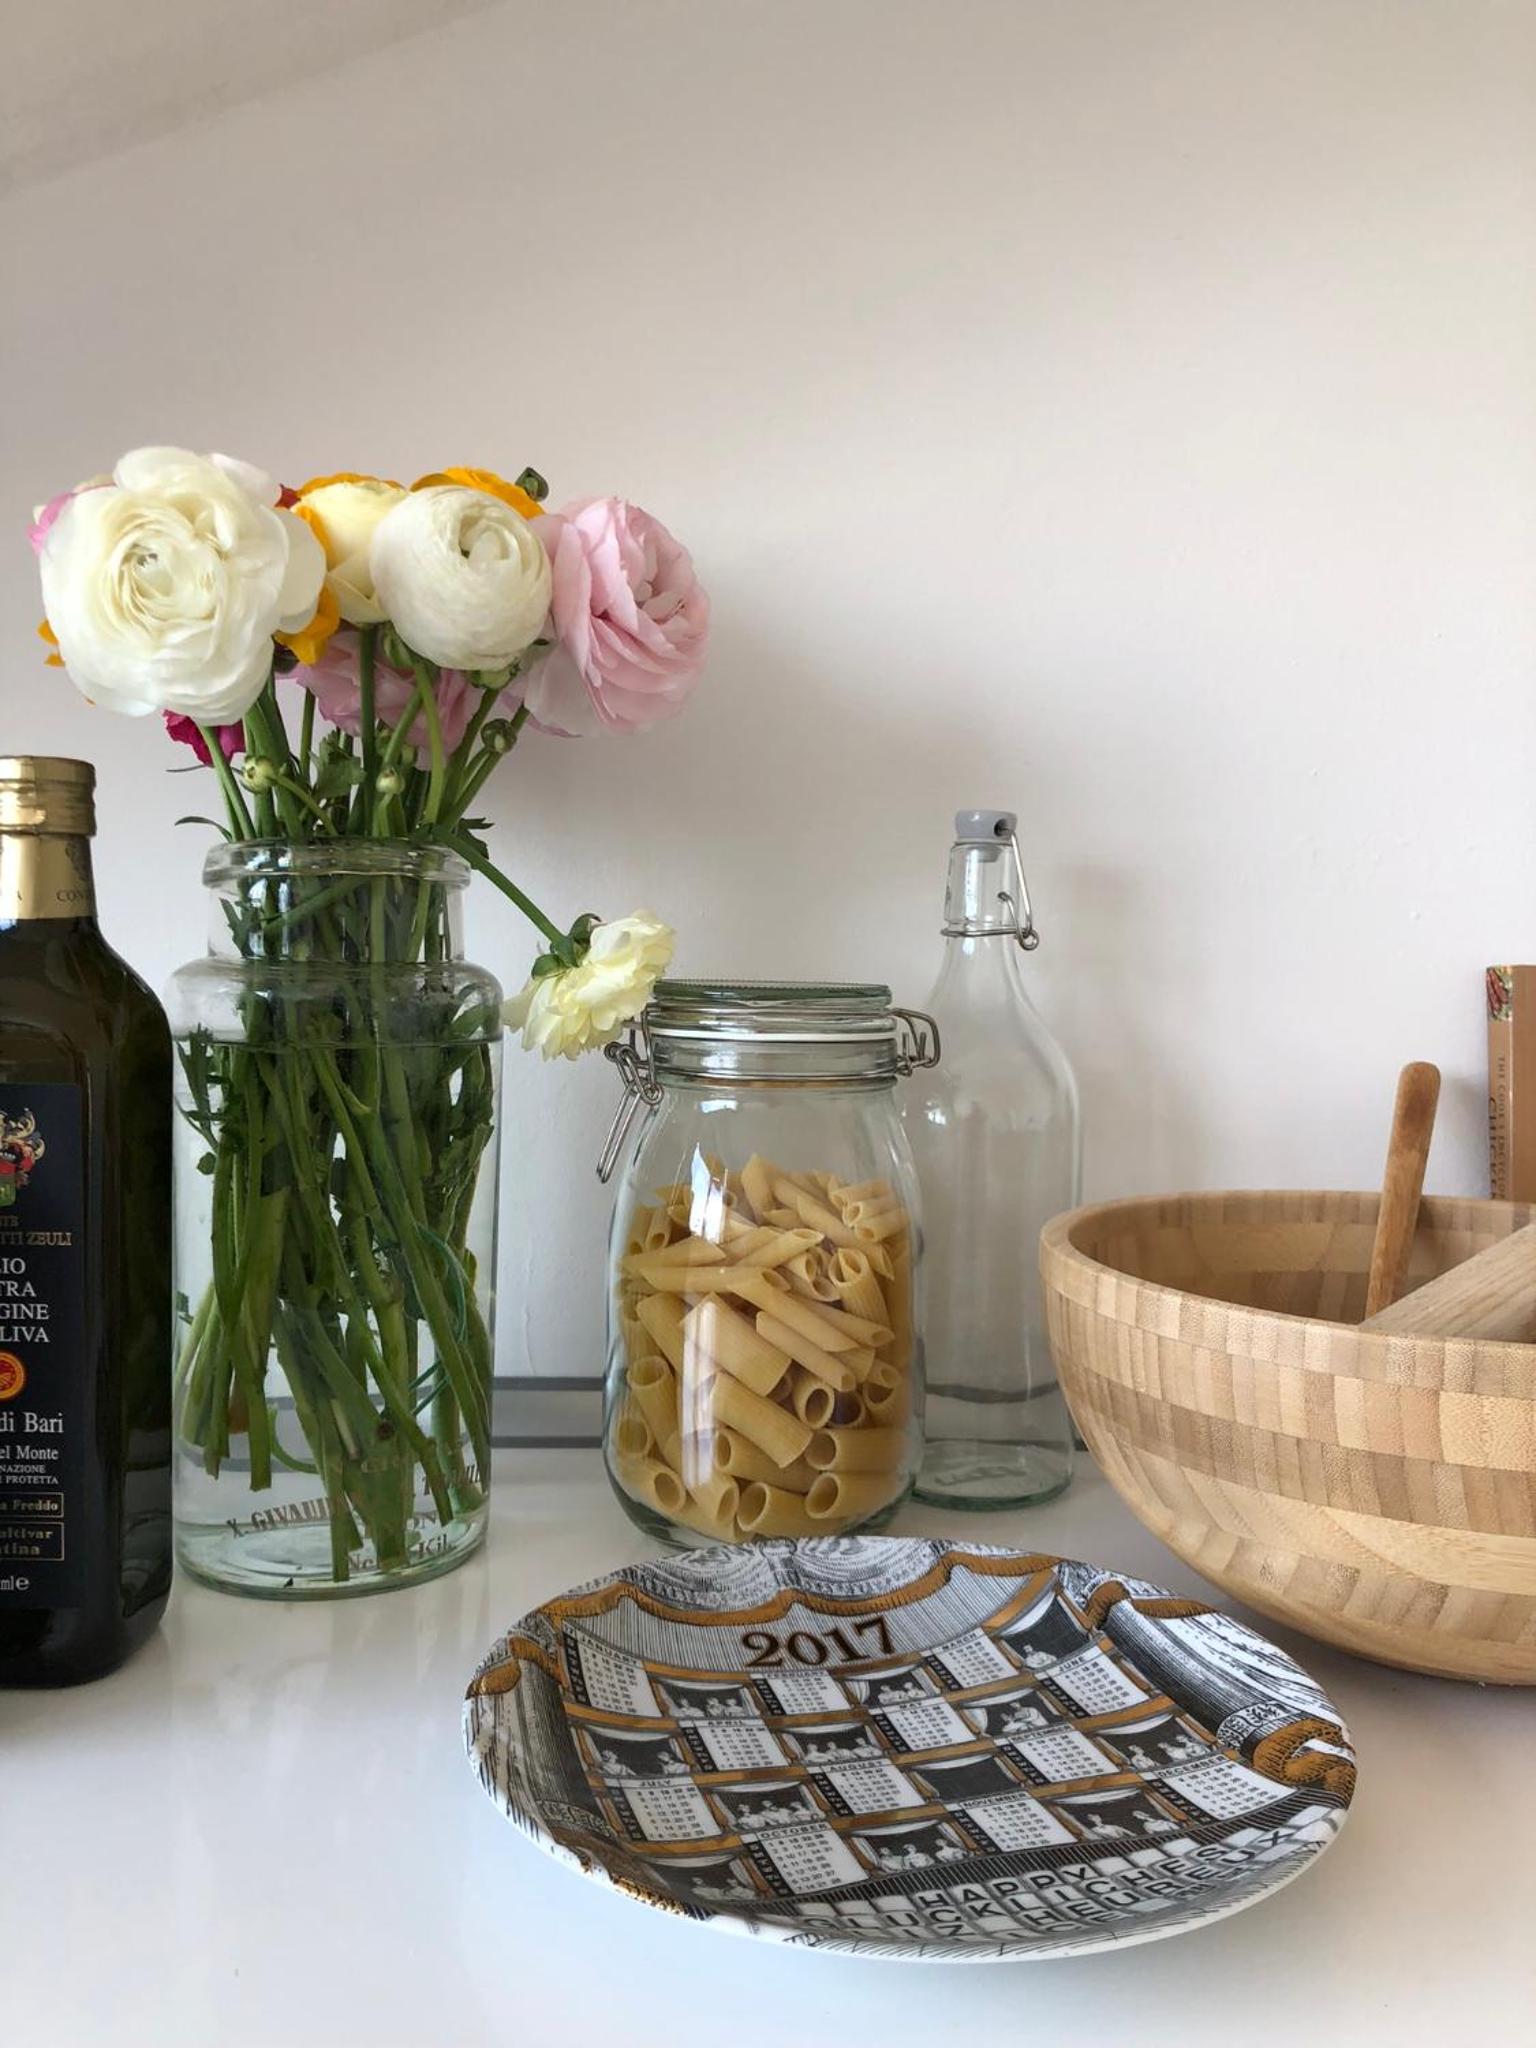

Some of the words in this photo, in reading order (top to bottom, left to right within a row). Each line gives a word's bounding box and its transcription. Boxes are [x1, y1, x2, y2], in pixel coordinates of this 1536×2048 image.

[25, 1231, 72, 1247] ZEULI
[0, 1256, 27, 1275] IO
[0, 1326, 50, 1343] LIVA
[23, 1411, 64, 1434] Bari
[16, 1444, 59, 1461] Monte
[6, 1475, 59, 1485] PROTETTA
[12, 1498, 59, 1511] Freddo
[742, 1616, 897, 1668] 2017
[942, 1632, 977, 1650] MARCH
[582, 1636, 638, 1665] JANUARY
[1059, 1655, 1087, 1672] JUNE
[899, 1702, 922, 1710] MAY
[708, 1719, 743, 1727] APRIL
[830, 1761, 883, 1772] AUGUST
[1158, 1755, 1228, 1778] DECEMBER
[640, 1779, 671, 1787] JULY
[963, 1792, 1027, 1808] NOVEMBER
[760, 1823, 828, 1839] OCTOBER
[1023, 1830, 1295, 1925] HEUREUX
[917, 1866, 1087, 1908] HAPPY
